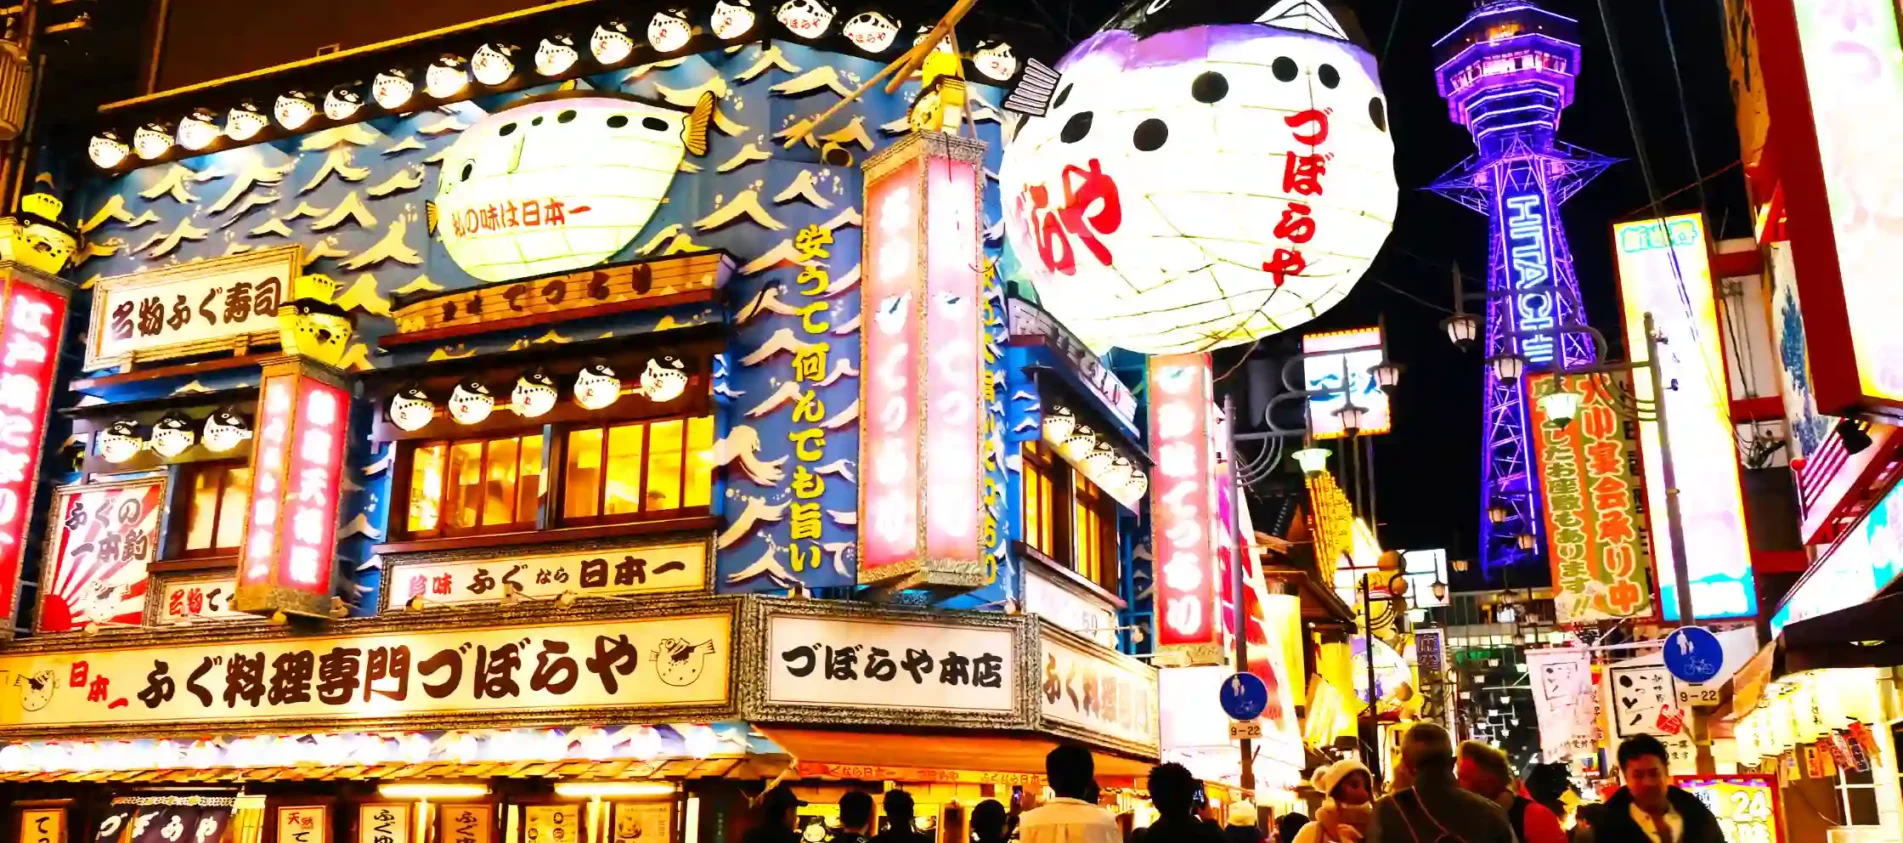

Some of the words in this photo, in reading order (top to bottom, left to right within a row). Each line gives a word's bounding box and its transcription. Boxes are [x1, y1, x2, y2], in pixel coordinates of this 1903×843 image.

[1262, 107, 1334, 287] づぼらや
[110, 276, 283, 341] 名物ふぐ寿司
[1506, 194, 1554, 362] HITACHI
[789, 223, 836, 573] 安うて何んでも旨い
[65, 497, 142, 531] ふぐの
[408, 571, 453, 596] 珍味
[68, 660, 130, 710] 日本一
[137, 634, 638, 709] ふぐ料理専門づぼらや
[781, 642, 1004, 690] づぼらや本店
[1731, 790, 1773, 822] 24
